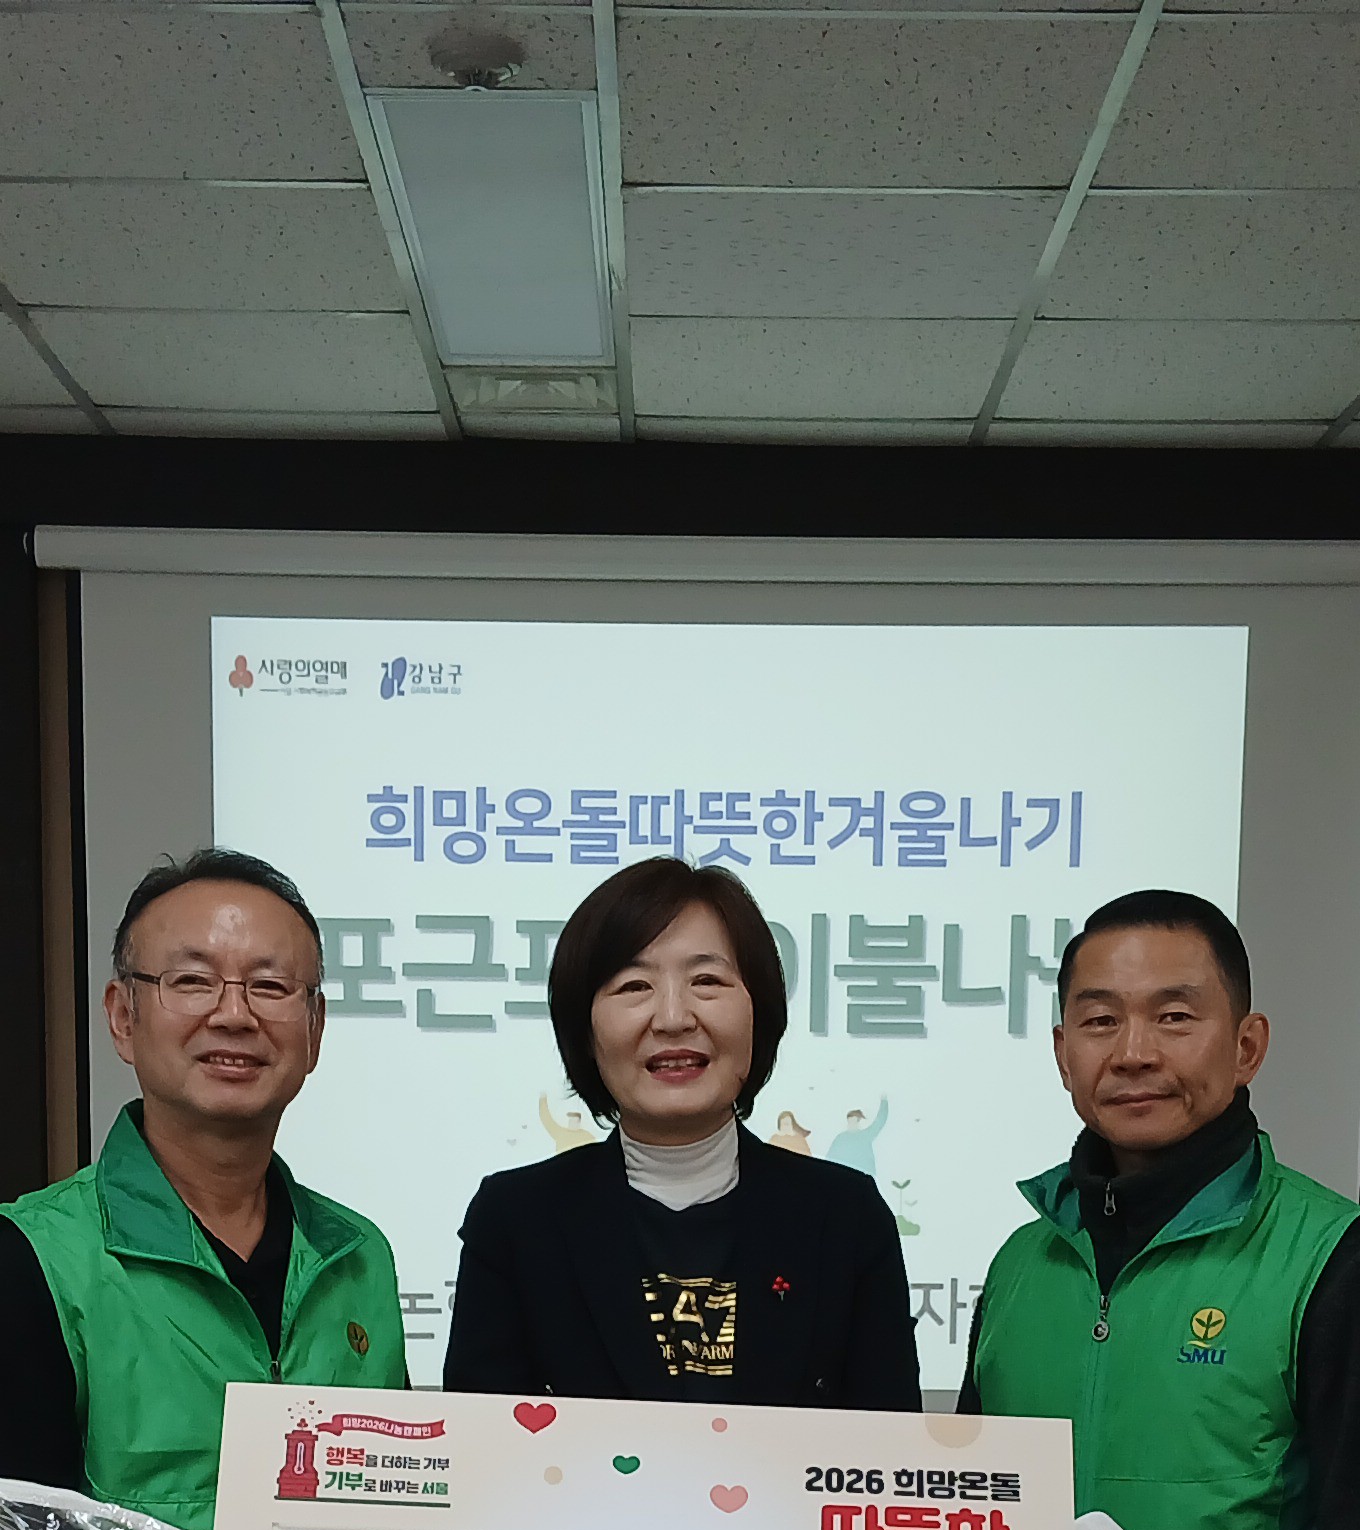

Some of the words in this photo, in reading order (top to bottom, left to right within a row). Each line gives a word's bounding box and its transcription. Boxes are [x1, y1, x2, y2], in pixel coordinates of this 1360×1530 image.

[259, 660, 347, 684] 사랑의열매
[409, 663, 461, 684] 강남구
[365, 783, 1084, 869] 희망온돌따뜻한겨울나기
[1175, 1345, 1230, 1368] SMU
[326, 1446, 378, 1467] 행복을
[382, 1456, 420, 1469] 더하는
[424, 1458, 449, 1470] 기부
[325, 1471, 376, 1492] 기부로
[380, 1480, 419, 1494] 바꾸는
[421, 1481, 449, 1495] 서울
[805, 1467, 884, 1494] 2026
[892, 1468, 1021, 1502] 희망온돌
